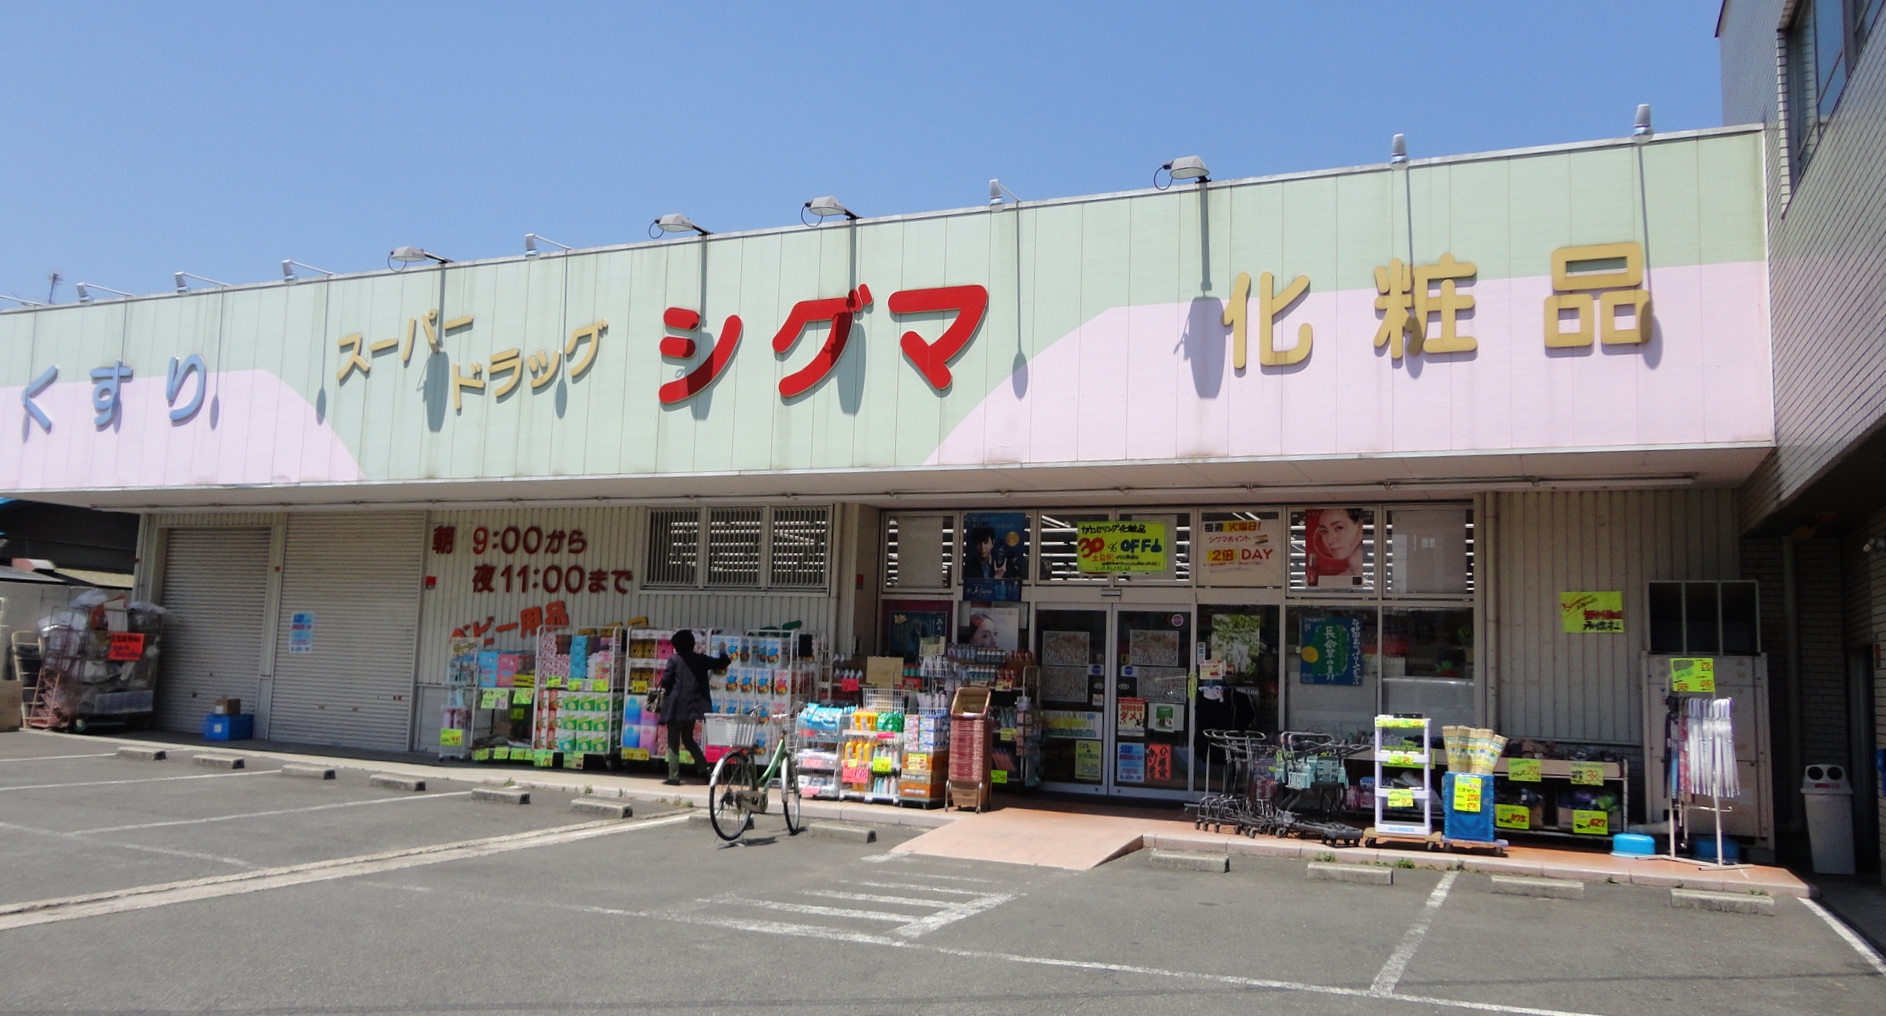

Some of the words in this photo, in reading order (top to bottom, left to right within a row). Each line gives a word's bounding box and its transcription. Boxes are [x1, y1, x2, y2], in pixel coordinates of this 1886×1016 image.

[1222, 241, 1652, 369] 化粧品
[337, 308, 474, 381] スーパー
[451, 319, 608, 412] ドラッグ
[659, 283, 989, 404] シグマ
[21, 353, 207, 431] くすり
[432, 525, 456, 554] 朝
[472, 526, 588, 555] 9:00から
[1241, 548, 1274, 560] DAY
[472, 563, 633, 595] 夜11:00まで
